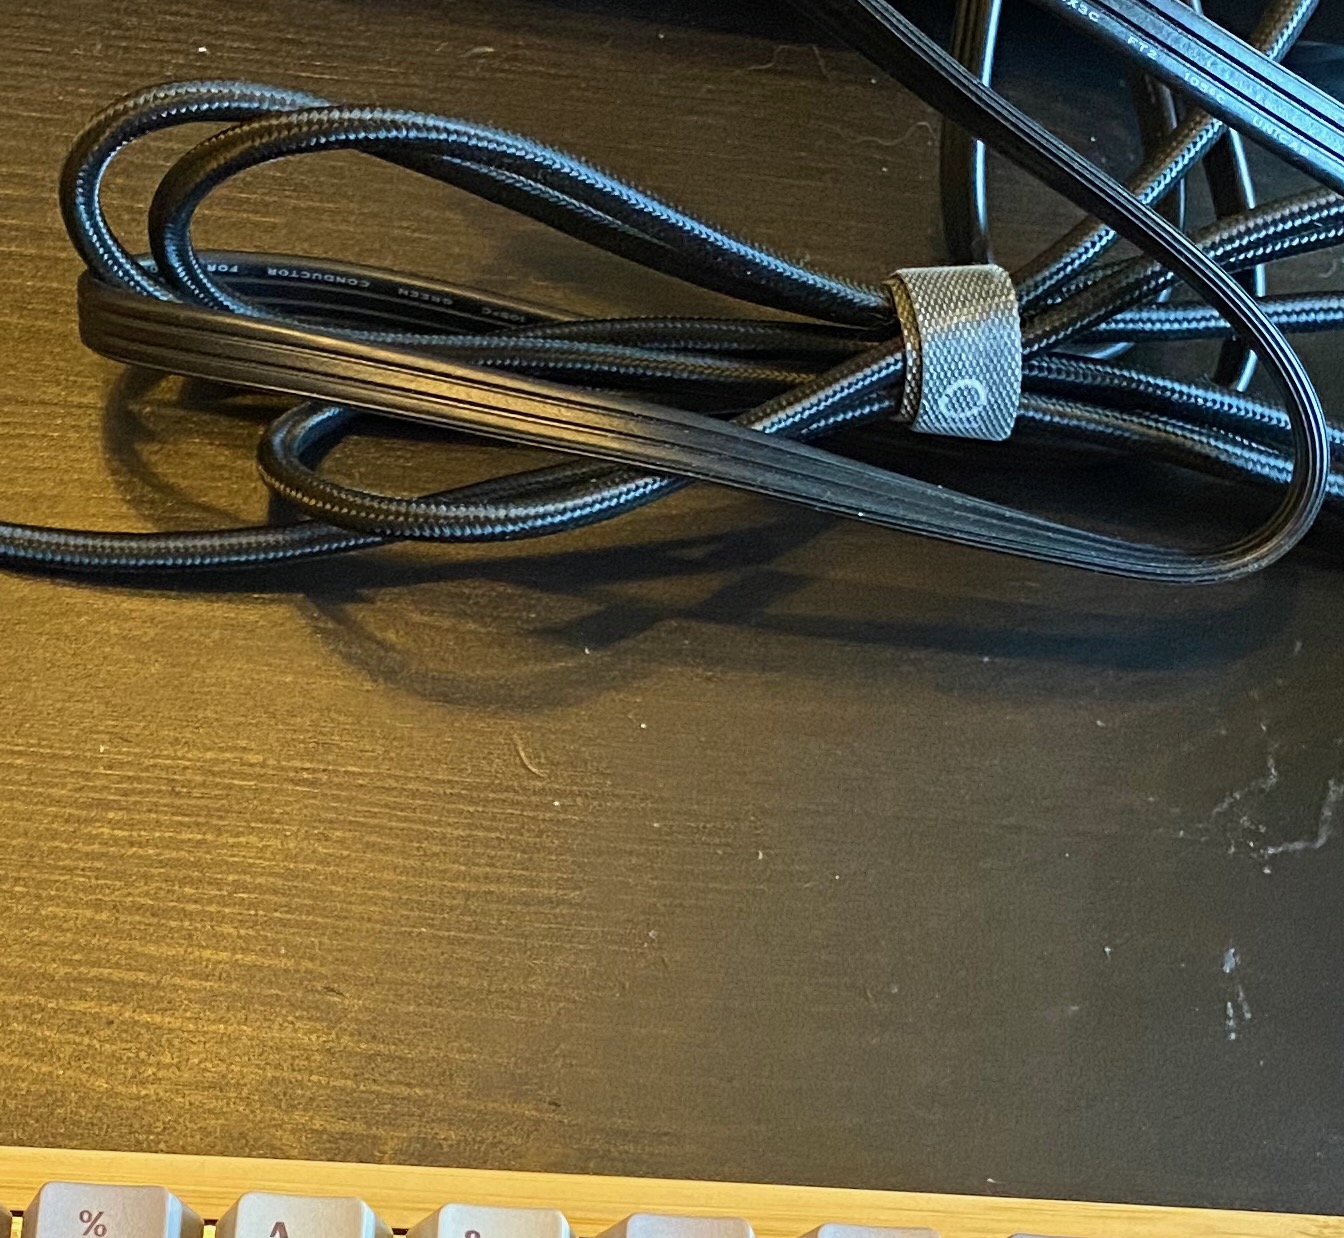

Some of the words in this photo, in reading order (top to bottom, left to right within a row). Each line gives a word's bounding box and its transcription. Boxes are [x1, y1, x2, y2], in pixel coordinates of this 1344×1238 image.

[1062, 0, 1100, 22] X3C
[206, 264, 238, 273] FOR
[266, 266, 371, 289] CONDUCTOR
[397, 287, 454, 306] GREEN
[79, 1209, 108, 1238] %
